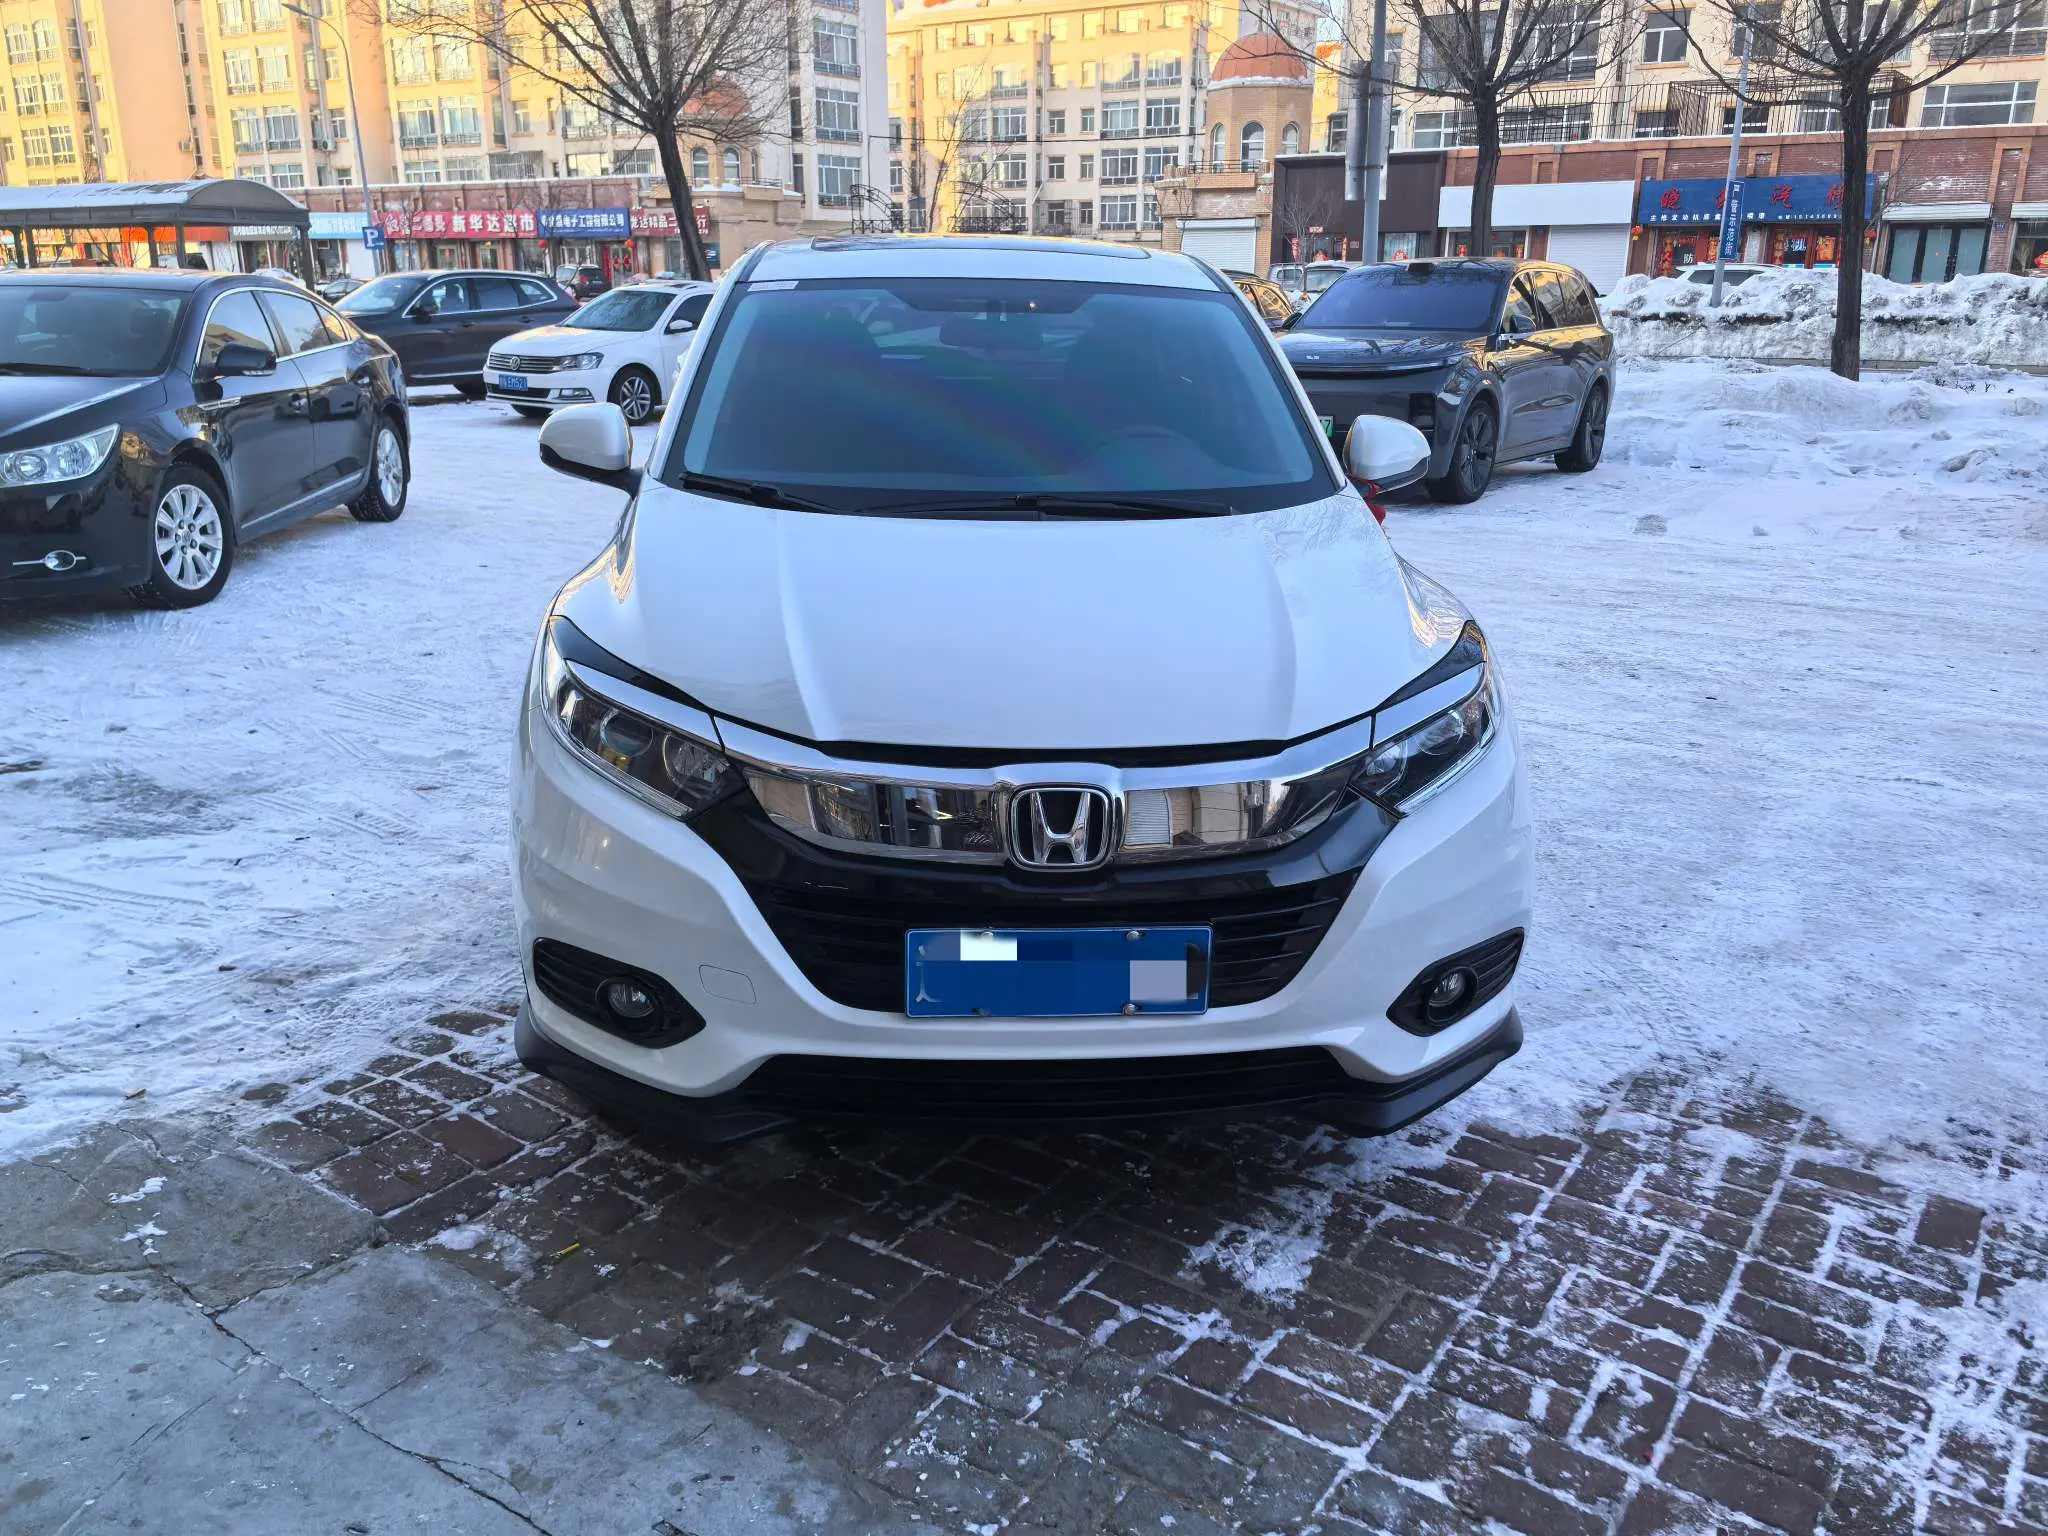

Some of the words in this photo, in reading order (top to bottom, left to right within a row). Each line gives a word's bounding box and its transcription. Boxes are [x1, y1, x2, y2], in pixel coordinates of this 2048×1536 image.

[1725, 184, 1740, 256] 严管示范街
